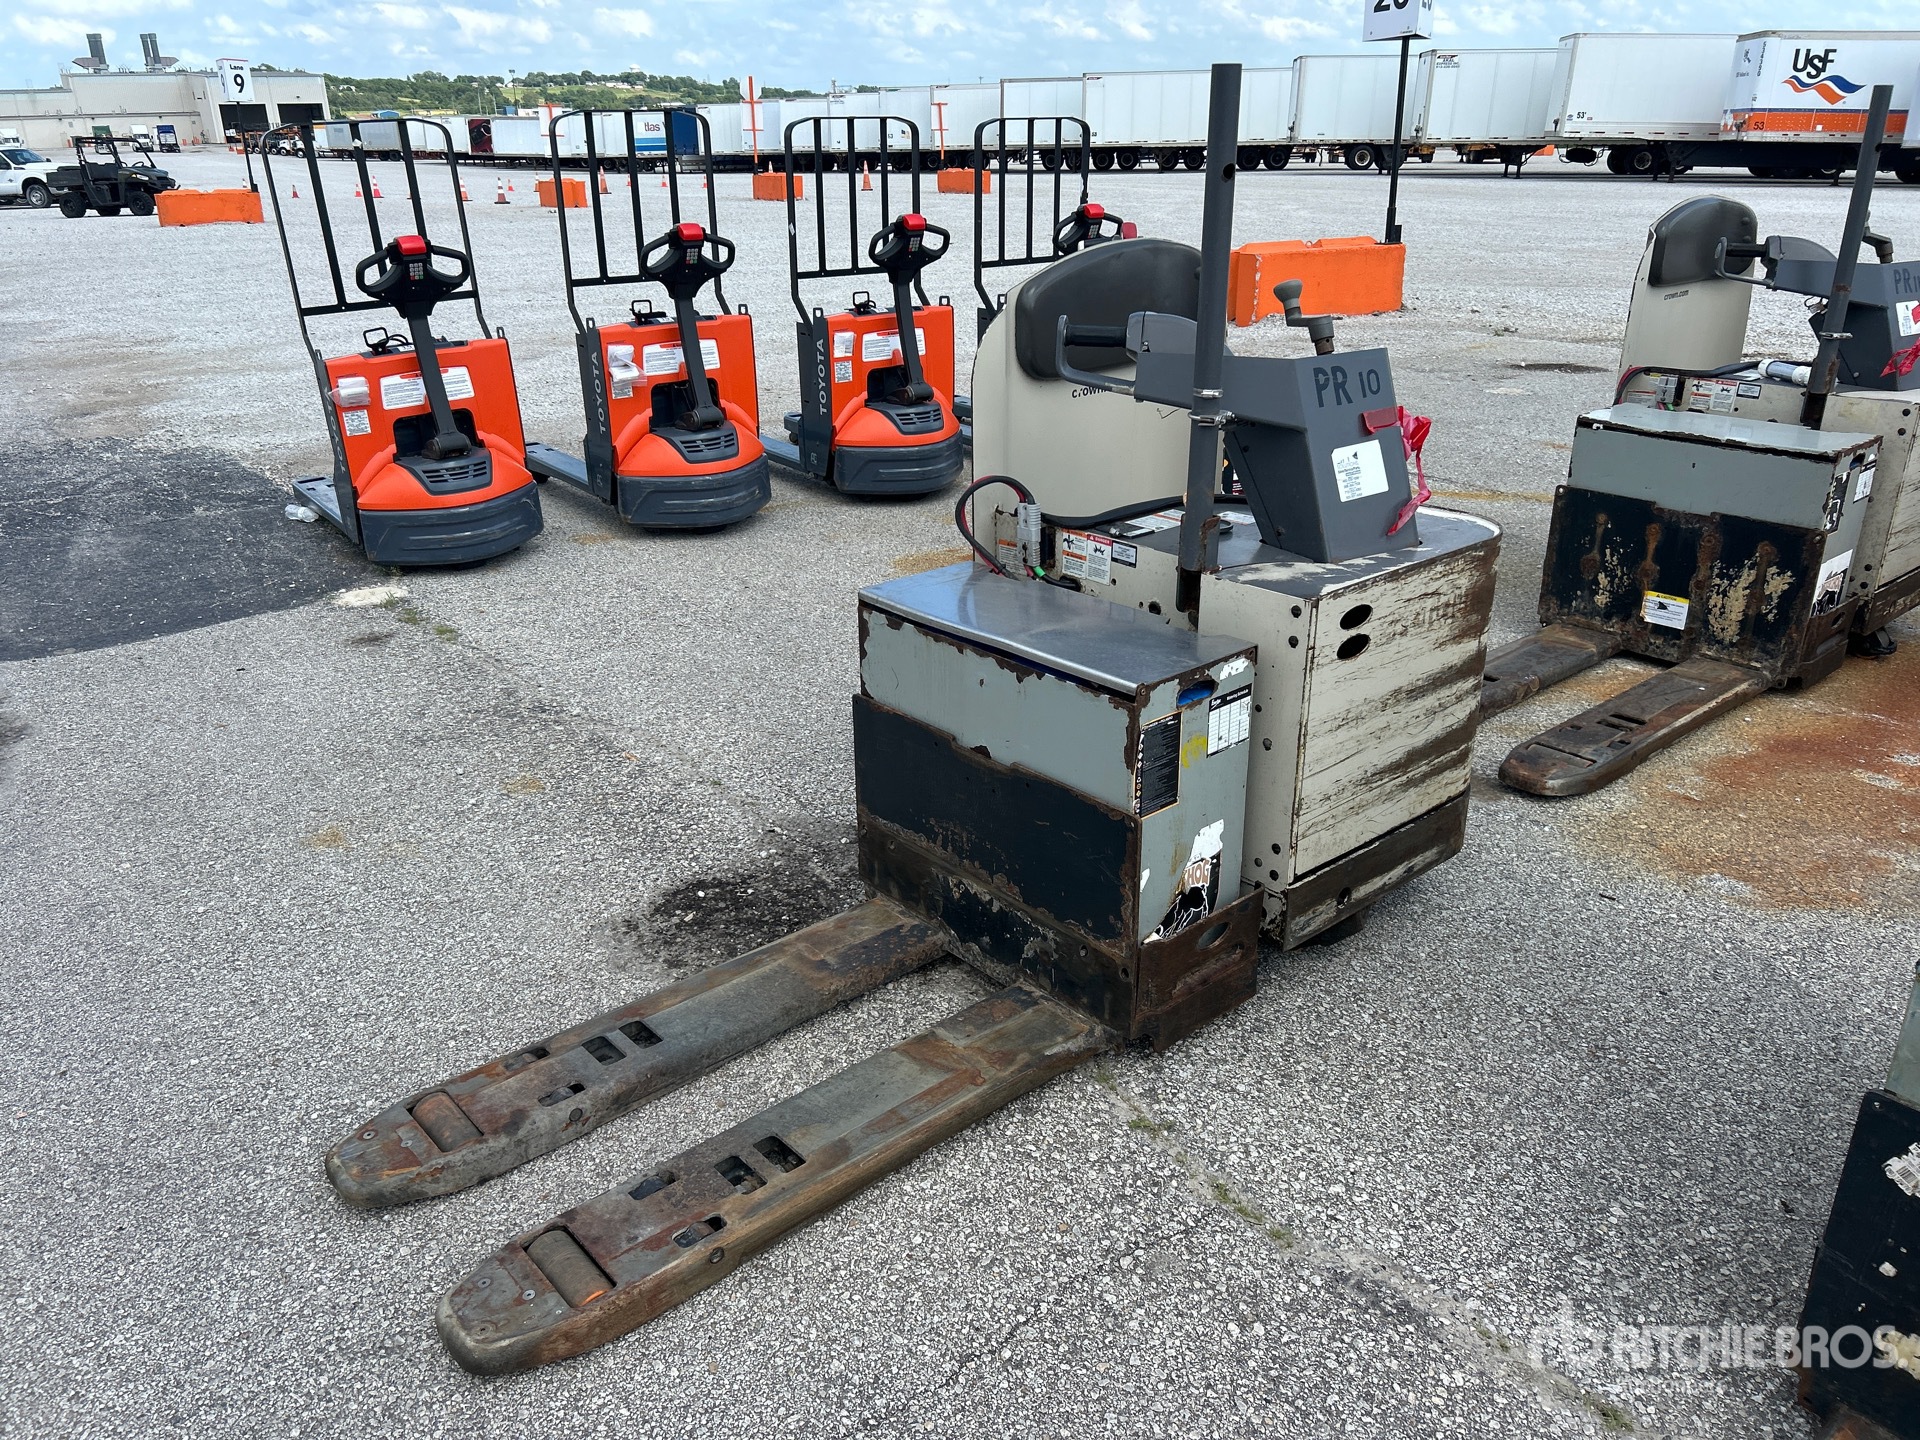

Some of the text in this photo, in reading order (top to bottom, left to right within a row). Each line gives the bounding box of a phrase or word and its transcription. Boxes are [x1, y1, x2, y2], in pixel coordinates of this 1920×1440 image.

[229, 63, 244, 71] Lane
[1792, 48, 1837, 79] USF
[233, 73, 245, 93] 9
[1753, 121, 1765, 130] 53
[1663, 289, 1689, 301] crown.com
[816, 338, 828, 416] TOYOTA
[1312, 365, 1354, 408] PR
[591, 351, 606, 435] TOYOTA
